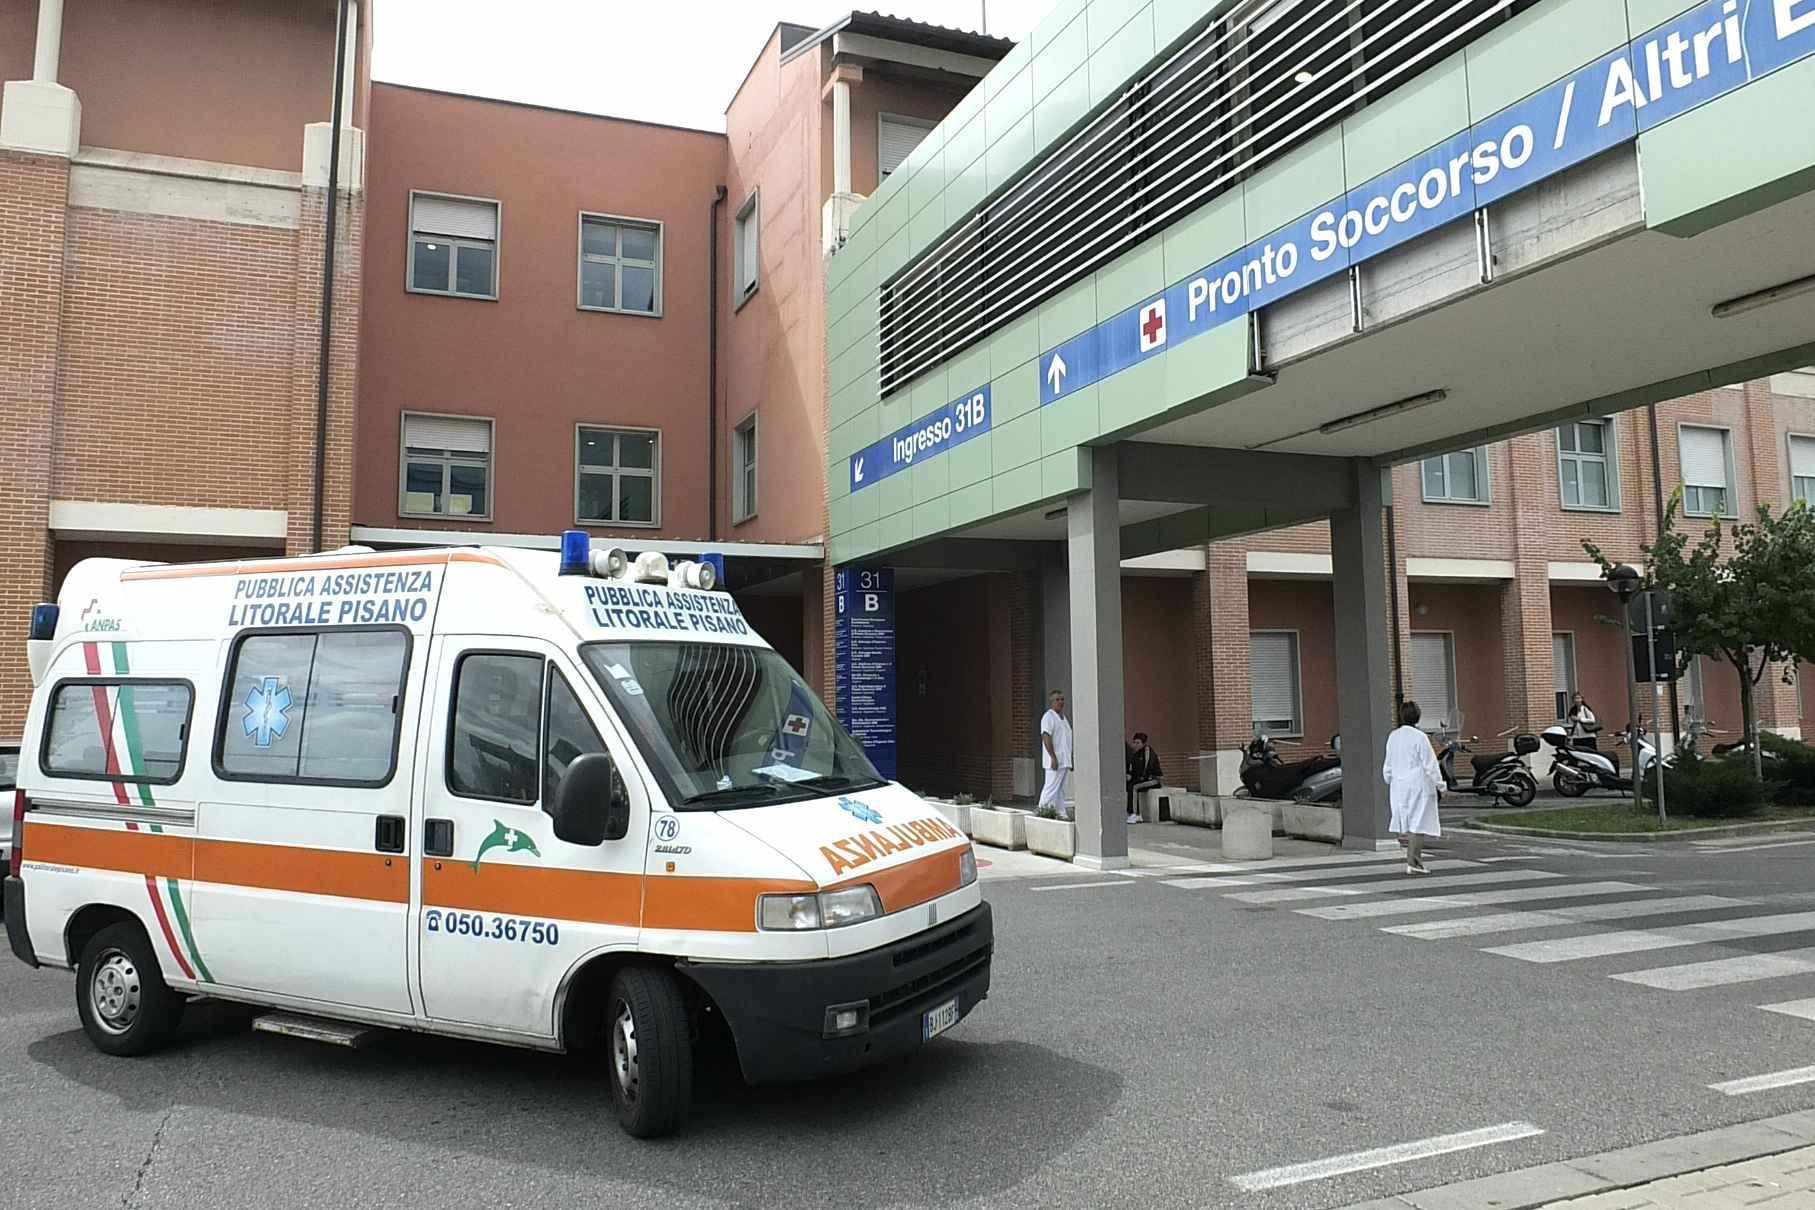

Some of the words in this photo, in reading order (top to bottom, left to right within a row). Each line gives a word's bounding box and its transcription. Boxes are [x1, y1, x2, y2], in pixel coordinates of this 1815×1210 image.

[1188, 242, 1298, 321] Pronto
[1310, 125, 1534, 262] Soccorso
[1553, 80, 1575, 149] /
[1598, 1, 1743, 128] Altri
[893, 417, 951, 464] Ingresso
[955, 393, 985, 433] 31B
[234, 575, 315, 599] PUBBLICA
[320, 570, 432, 596] ASSISTENZA
[860, 571, 880, 589] 31
[228, 601, 333, 626] LITORALE
[338, 598, 428, 624] PISANO
[584, 585, 665, 609] PUBBLICA
[665, 591, 742, 616] ASSISTENZA
[838, 595, 845, 614] B
[865, 594, 879, 611] B
[592, 608, 689, 631] LITORALE
[687, 612, 748, 635] PISANO
[660, 820, 676, 837] 78
[445, 911, 559, 945] 050.36750
